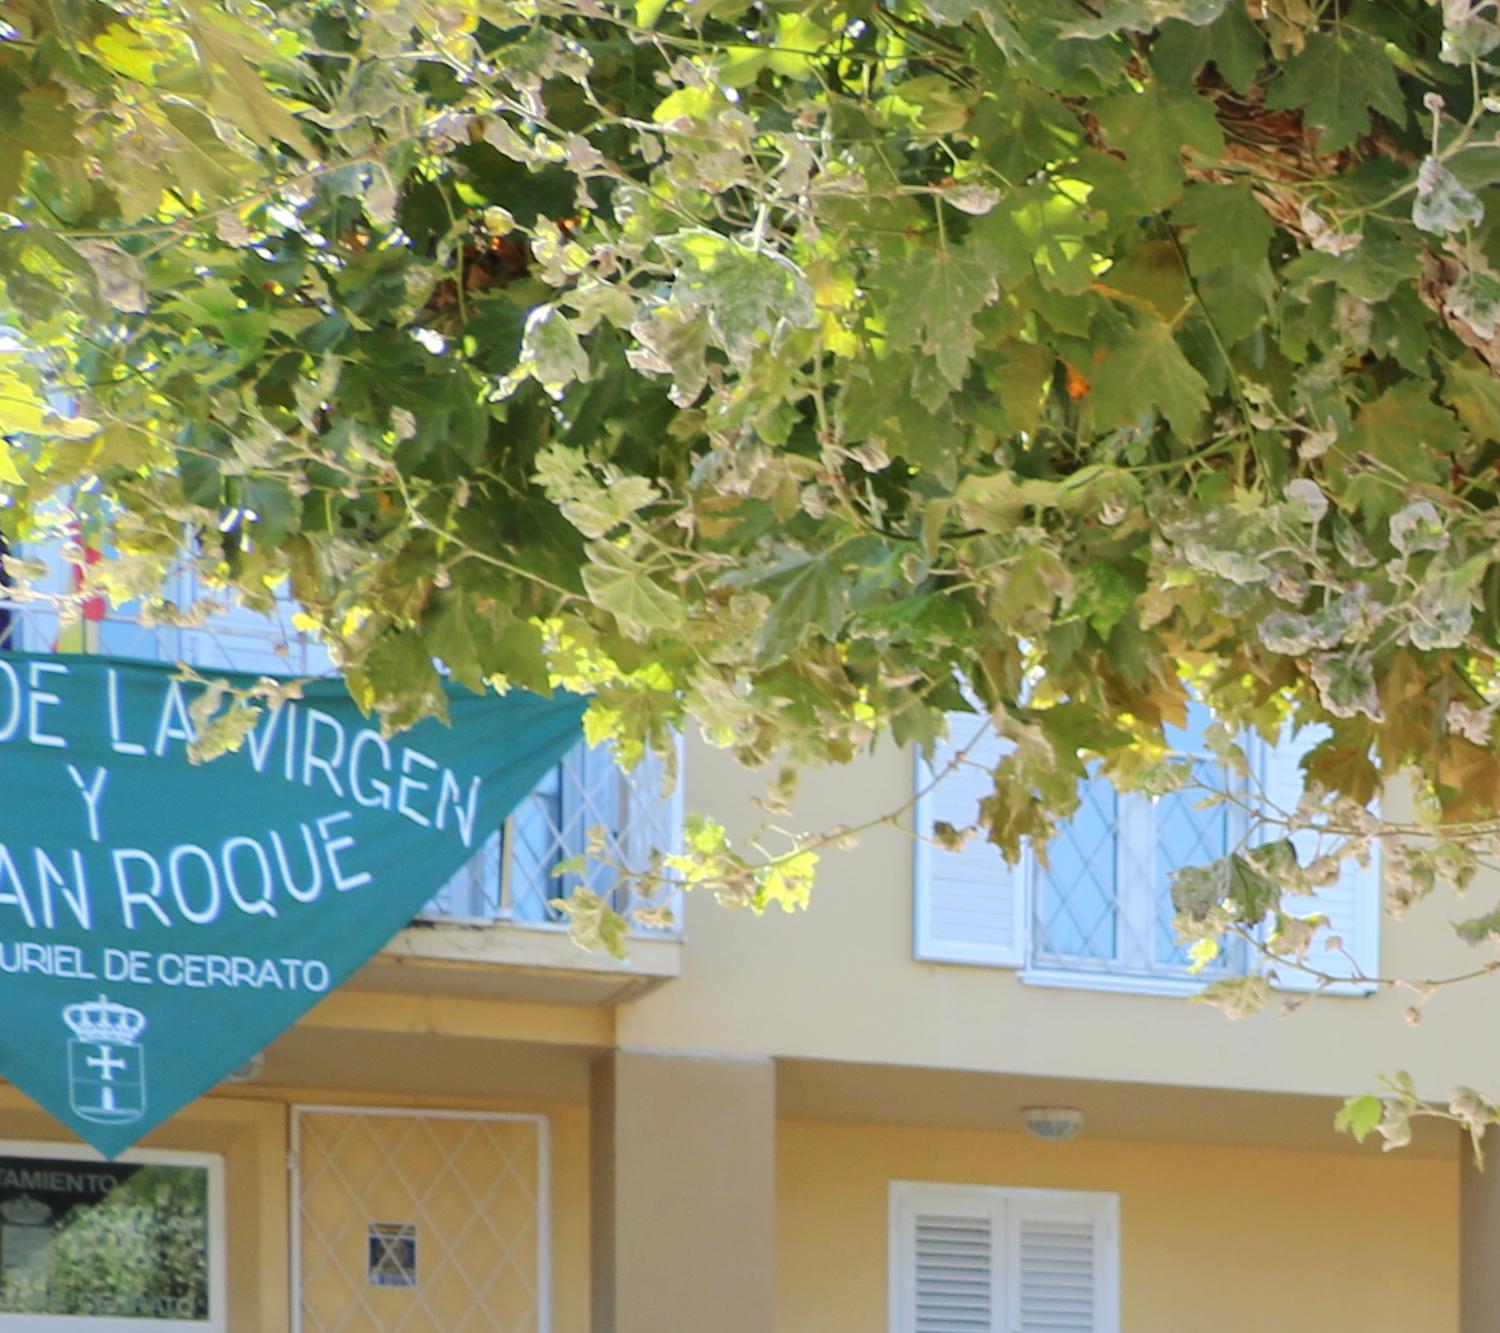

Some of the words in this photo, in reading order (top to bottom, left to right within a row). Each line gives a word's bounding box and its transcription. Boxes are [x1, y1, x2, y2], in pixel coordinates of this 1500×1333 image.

[67, 764, 109, 842] Y
[107, 668, 198, 757] LA
[243, 702, 482, 848] VIRGEN
[111, 810, 373, 930] ROQUE
[103, 949, 153, 983] DE
[156, 952, 330, 992] CERRATO
